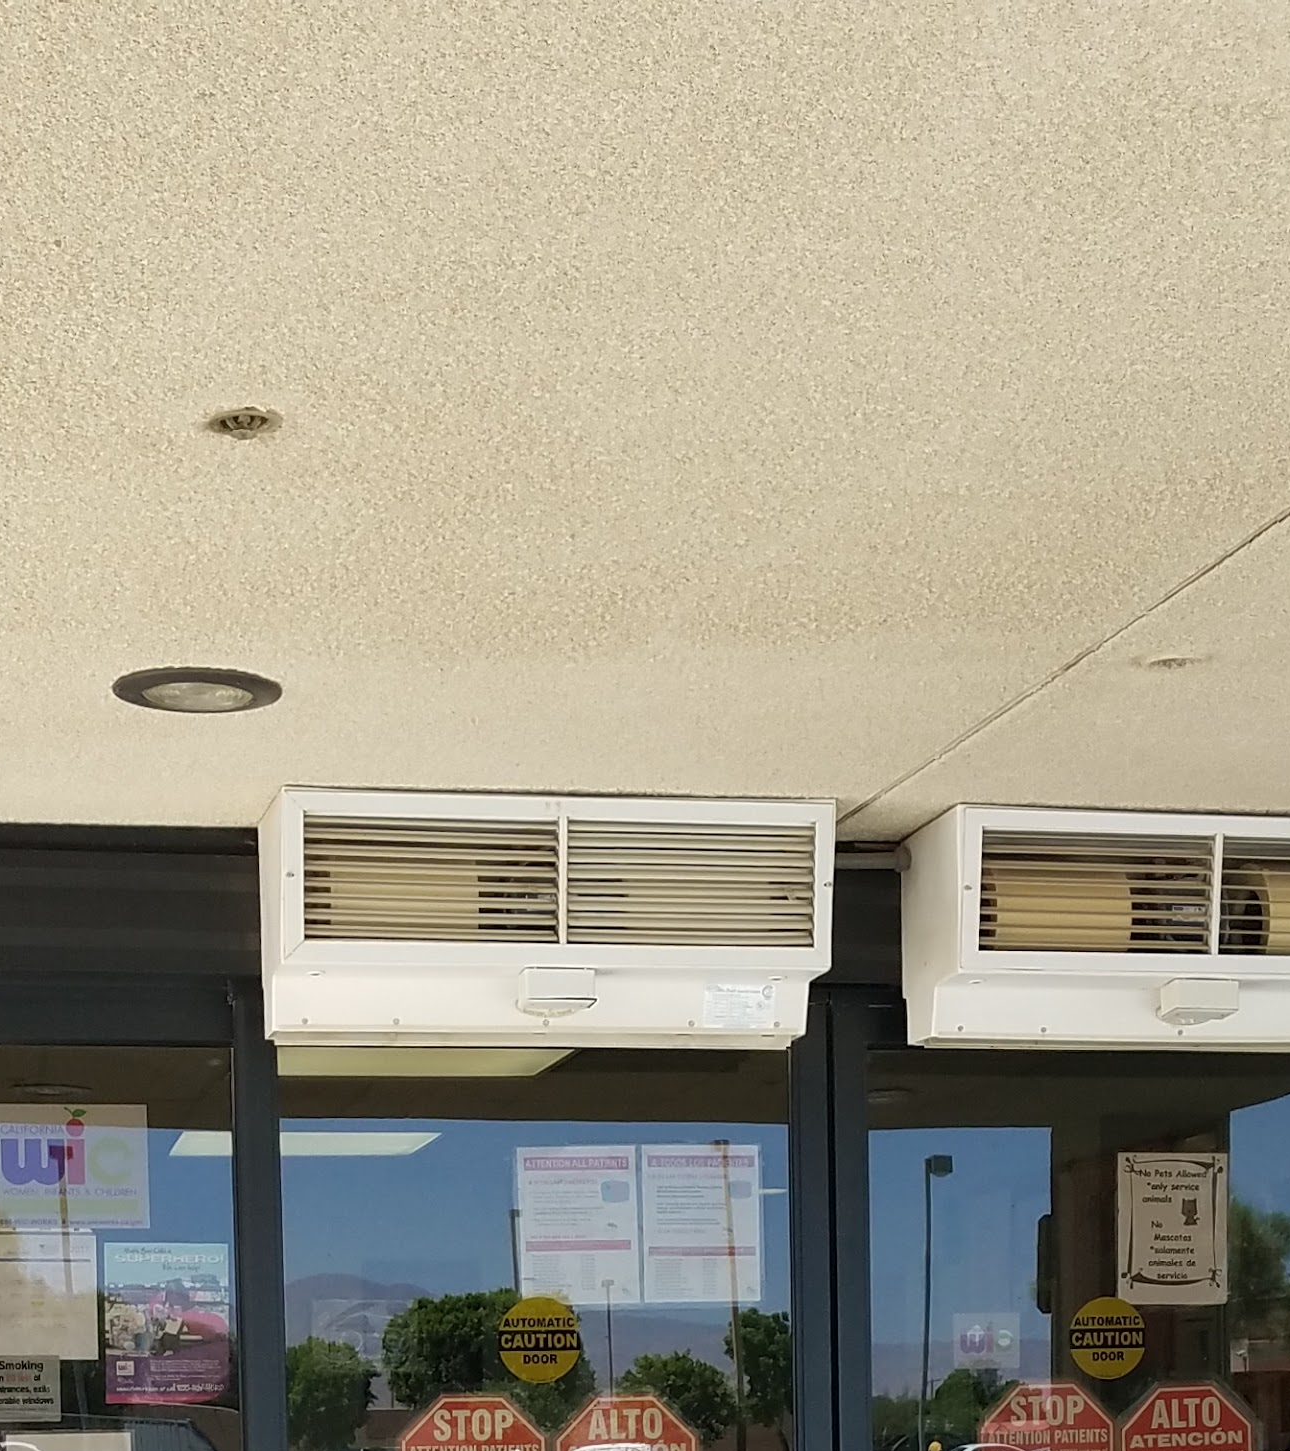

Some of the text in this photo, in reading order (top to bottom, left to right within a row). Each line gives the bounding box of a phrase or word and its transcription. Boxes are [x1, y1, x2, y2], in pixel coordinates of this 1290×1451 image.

[0, 1125, 65, 1135] CALIFORNIA
[525, 1158, 628, 1168] ATTENTION ALL PATIENTS
[1139, 1169, 1207, 1178] No Pets Allowed
[1170, 1184, 1200, 1192] service
[1142, 1195, 1172, 1203] animals
[1151, 1220, 1163, 1229] No
[1153, 1234, 1192, 1242] Mascotas
[115, 1254, 224, 1263] SUPERHERO!
[1148, 1259, 1196, 1267] animales de
[1157, 1272, 1188, 1280] servicio
[503, 1317, 575, 1328] AUTOMATIC
[1074, 1316, 1140, 1327] AUTOMATIC
[501, 1333, 578, 1349] CAUTION
[1071, 1331, 1143, 1347] CAUTION
[523, 1354, 558, 1365] DOOR
[1092, 1351, 1125, 1362] DOOR
[22, 1397, 54, 1405] windows
[1010, 1395, 1085, 1426] STOP
[1151, 1397, 1221, 1429] ALTO
[433, 1409, 514, 1441] STOP
[587, 1408, 663, 1440] ALTO
[989, 1429, 1108, 1445] ATTENTION PATIENTS
[1130, 1428, 1243, 1449] ATENCIÓN
